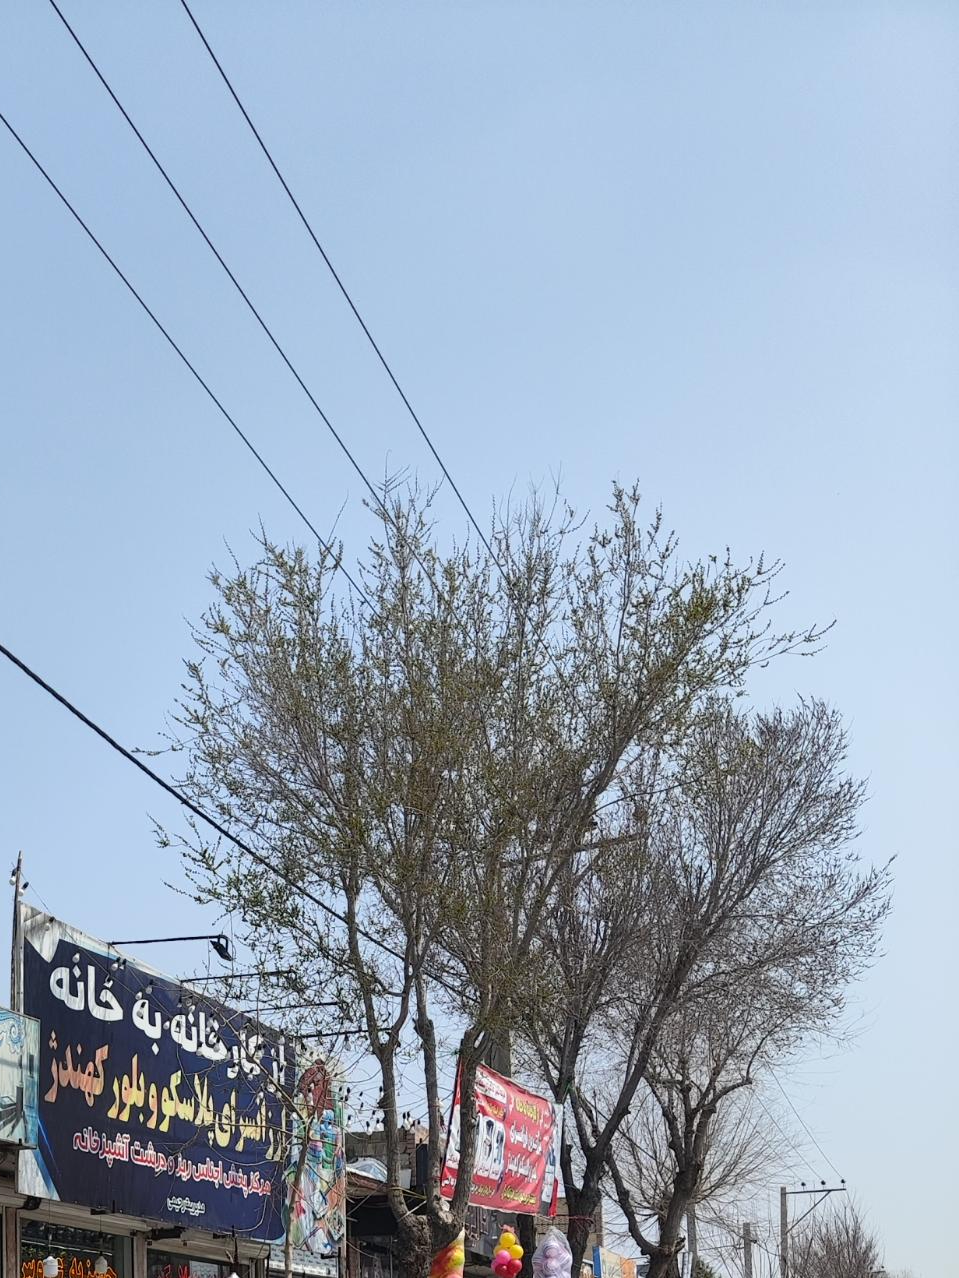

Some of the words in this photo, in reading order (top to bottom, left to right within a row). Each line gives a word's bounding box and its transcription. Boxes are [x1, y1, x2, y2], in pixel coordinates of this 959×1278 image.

[50, 964, 123, 1021] خانه
[132, 999, 161, 1055] به
[44, 1029, 109, 1107] کهندژ
[107, 1053, 145, 1124] بلور
[147, 1083, 158, 1129] و
[130, 1141, 168, 1173] درشت
[167, 1155, 176, 1175] و
[175, 1152, 192, 1182] ریز
[192, 1157, 223, 1189] اجناس
[223, 1163, 249, 1199] پخش
